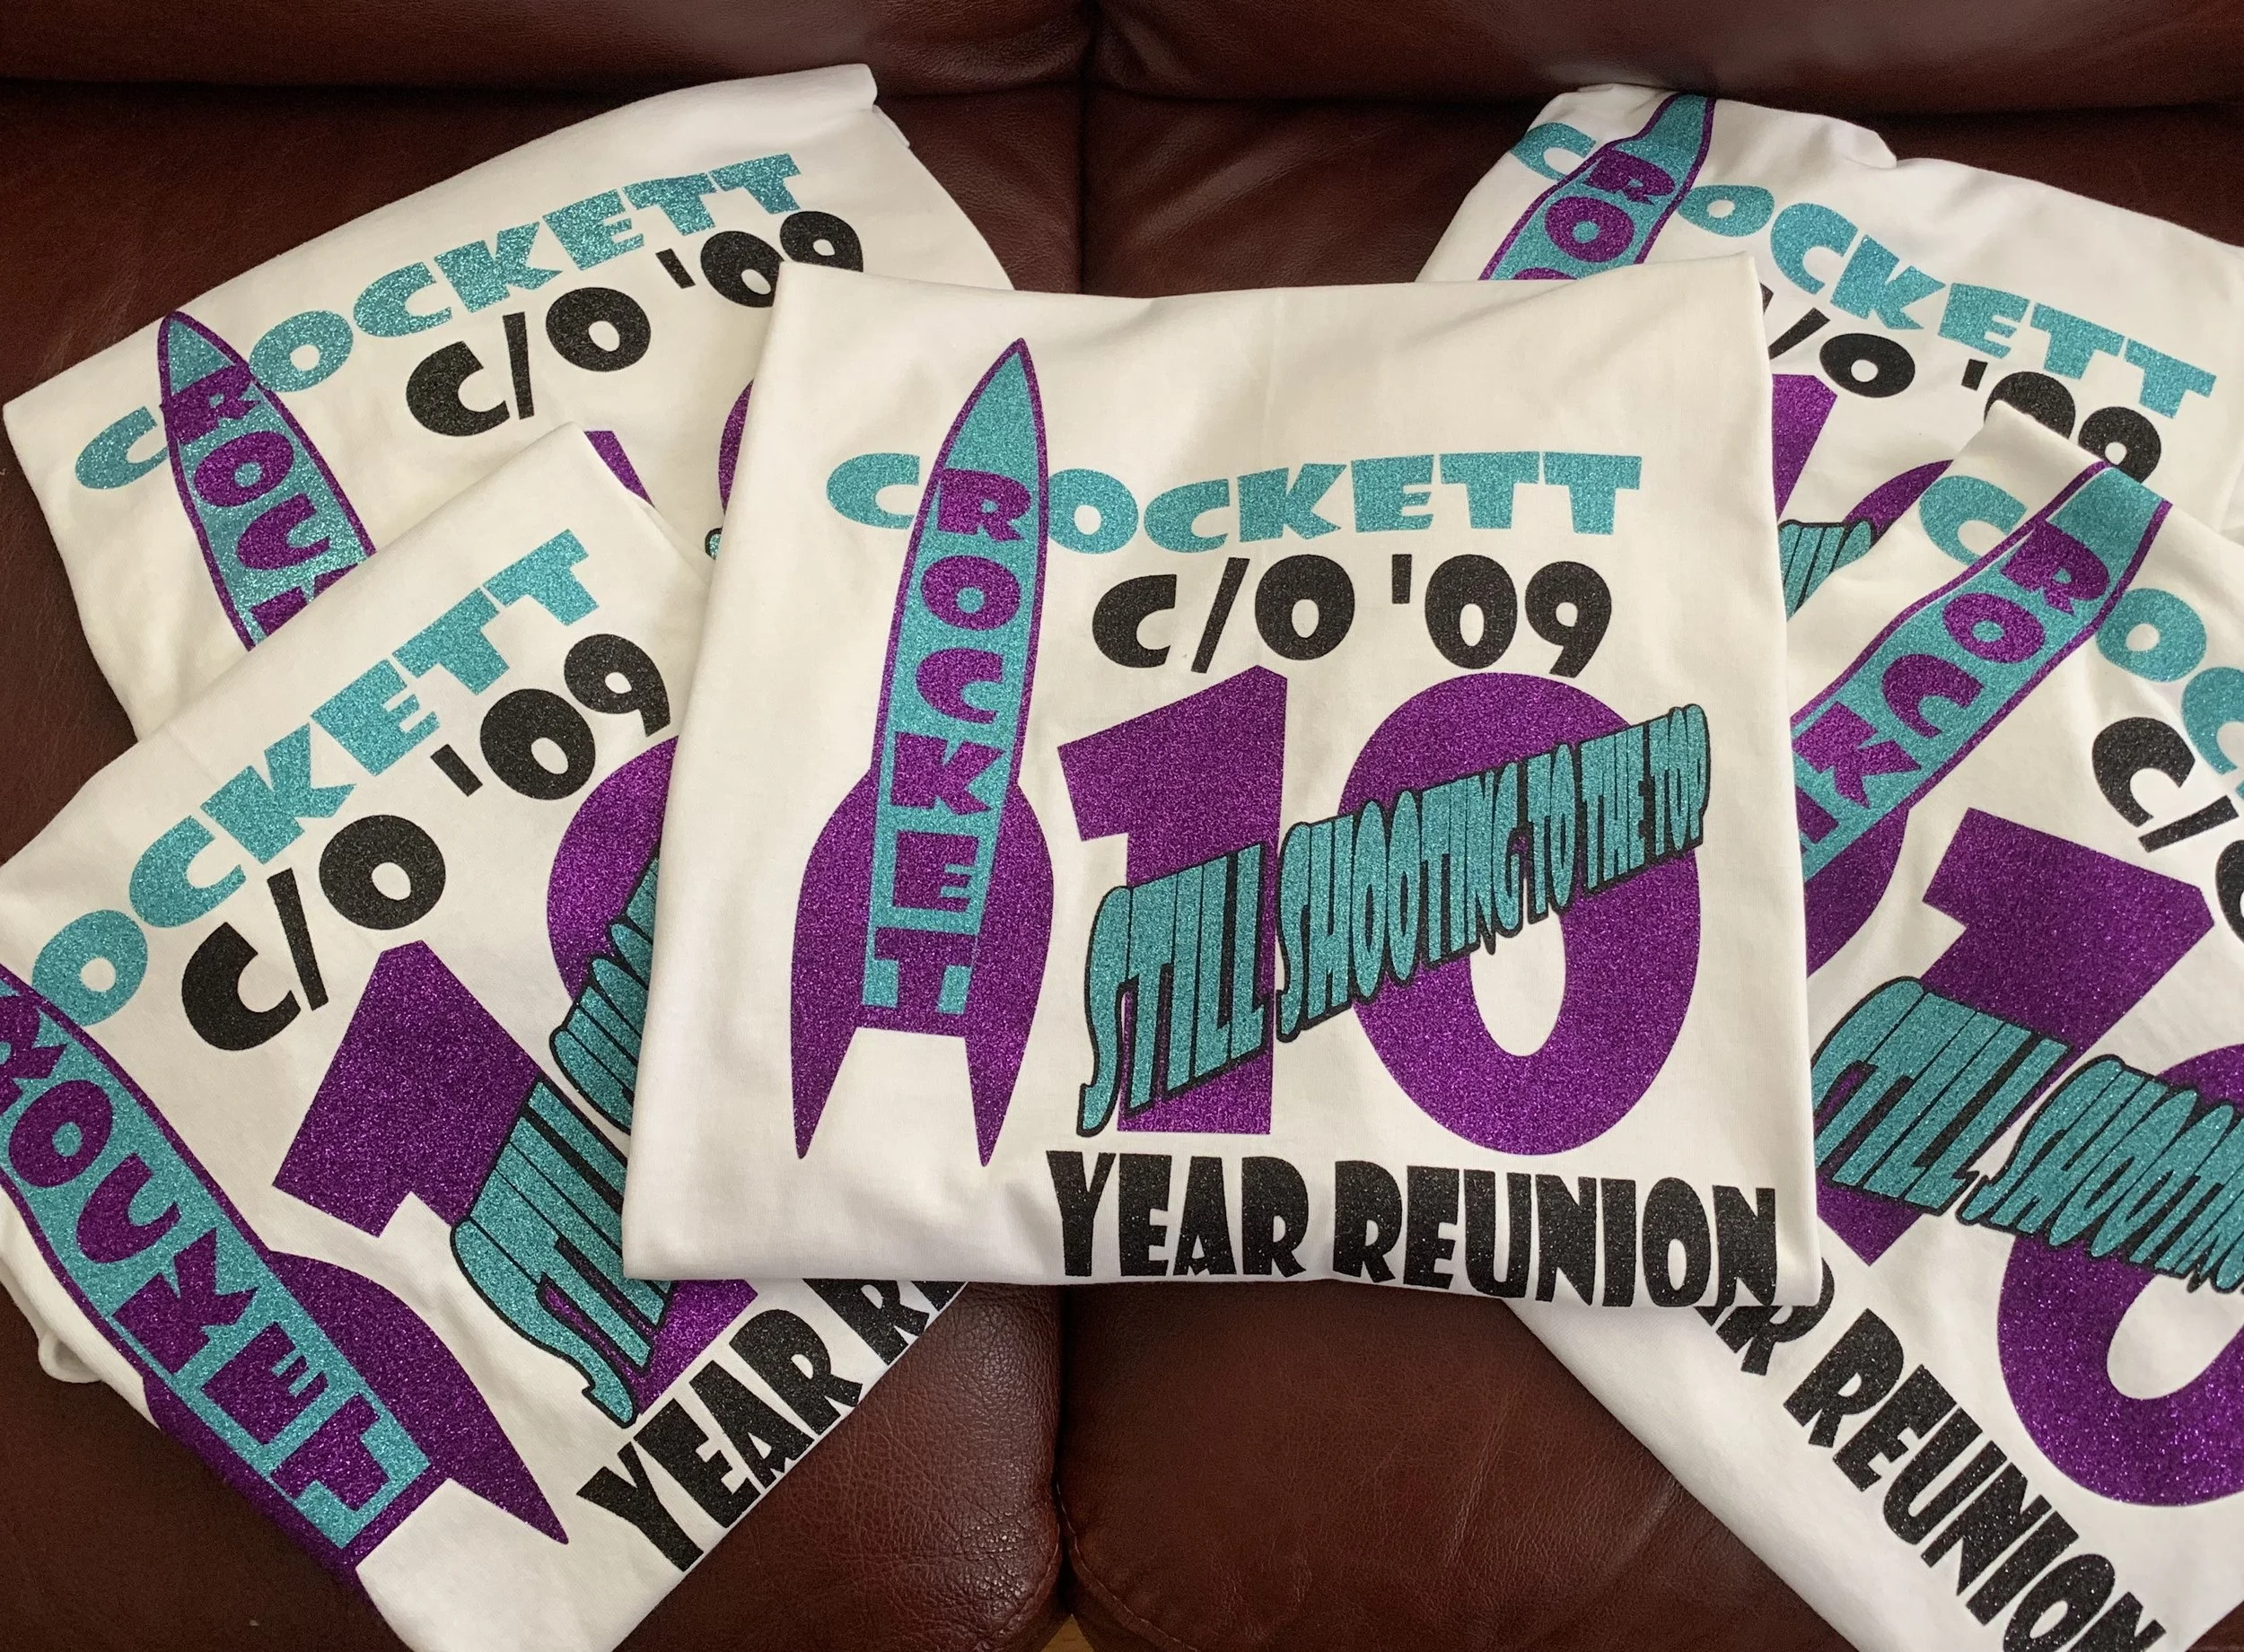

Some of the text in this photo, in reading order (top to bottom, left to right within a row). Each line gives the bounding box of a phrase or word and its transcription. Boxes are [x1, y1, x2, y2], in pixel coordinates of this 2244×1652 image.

[407, 287, 652, 436] C/O
[874, 468, 1031, 1014] ROCKET
[1091, 554, 1613, 678] C/O '09
[182, 815, 446, 1051] C/O
[430, 634, 671, 800] '09
[1057, 665, 1701, 1156] 10
[1076, 704, 1712, 1138] STILL SHOOTING TO THE TOP
[1047, 1150, 1777, 1307] YEAR REUNION
[576, 1309, 863, 1572] YEAR
